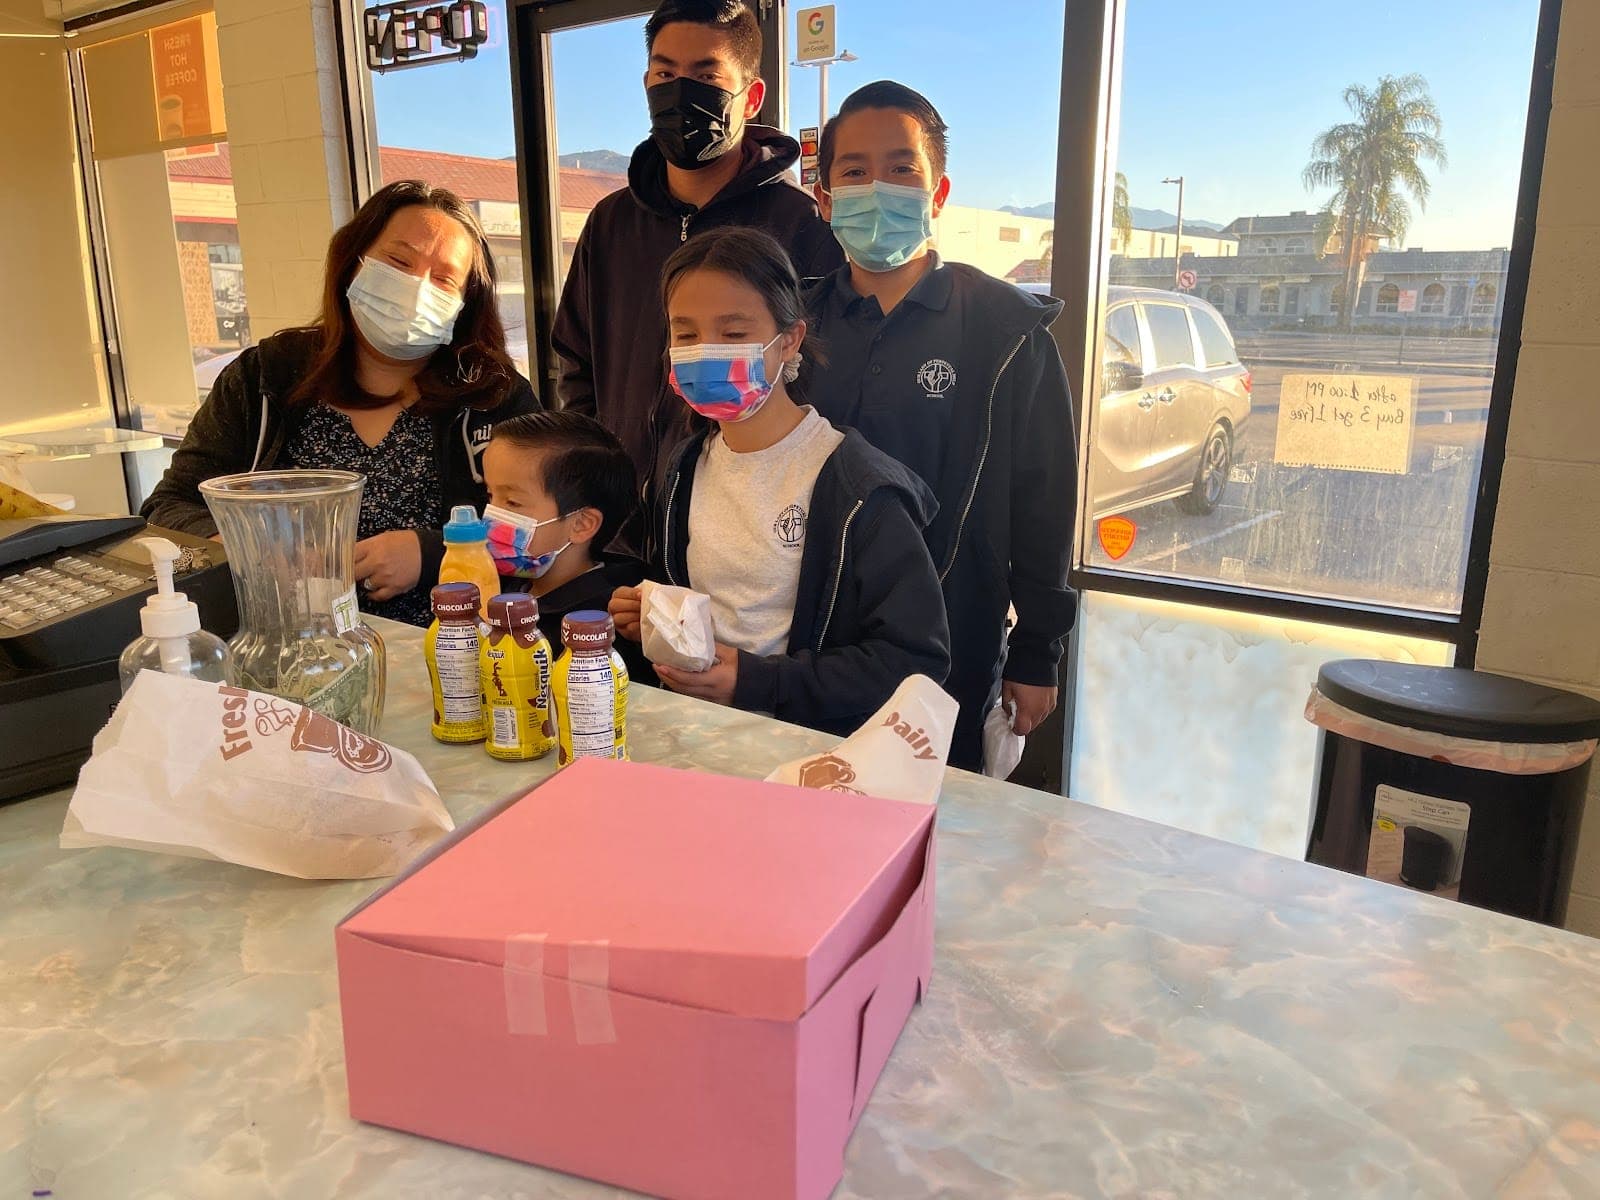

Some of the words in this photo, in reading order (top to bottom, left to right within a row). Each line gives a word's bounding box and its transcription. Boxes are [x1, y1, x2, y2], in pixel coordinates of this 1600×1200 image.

[437, 603, 474, 611] CHOCOLATE
[572, 632, 608, 642] CHOCOLATE
[466, 640, 478, 648] 140
[533, 648, 550, 709] Nesquik
[567, 674, 590, 682] Calories
[600, 671, 613, 679] 140
